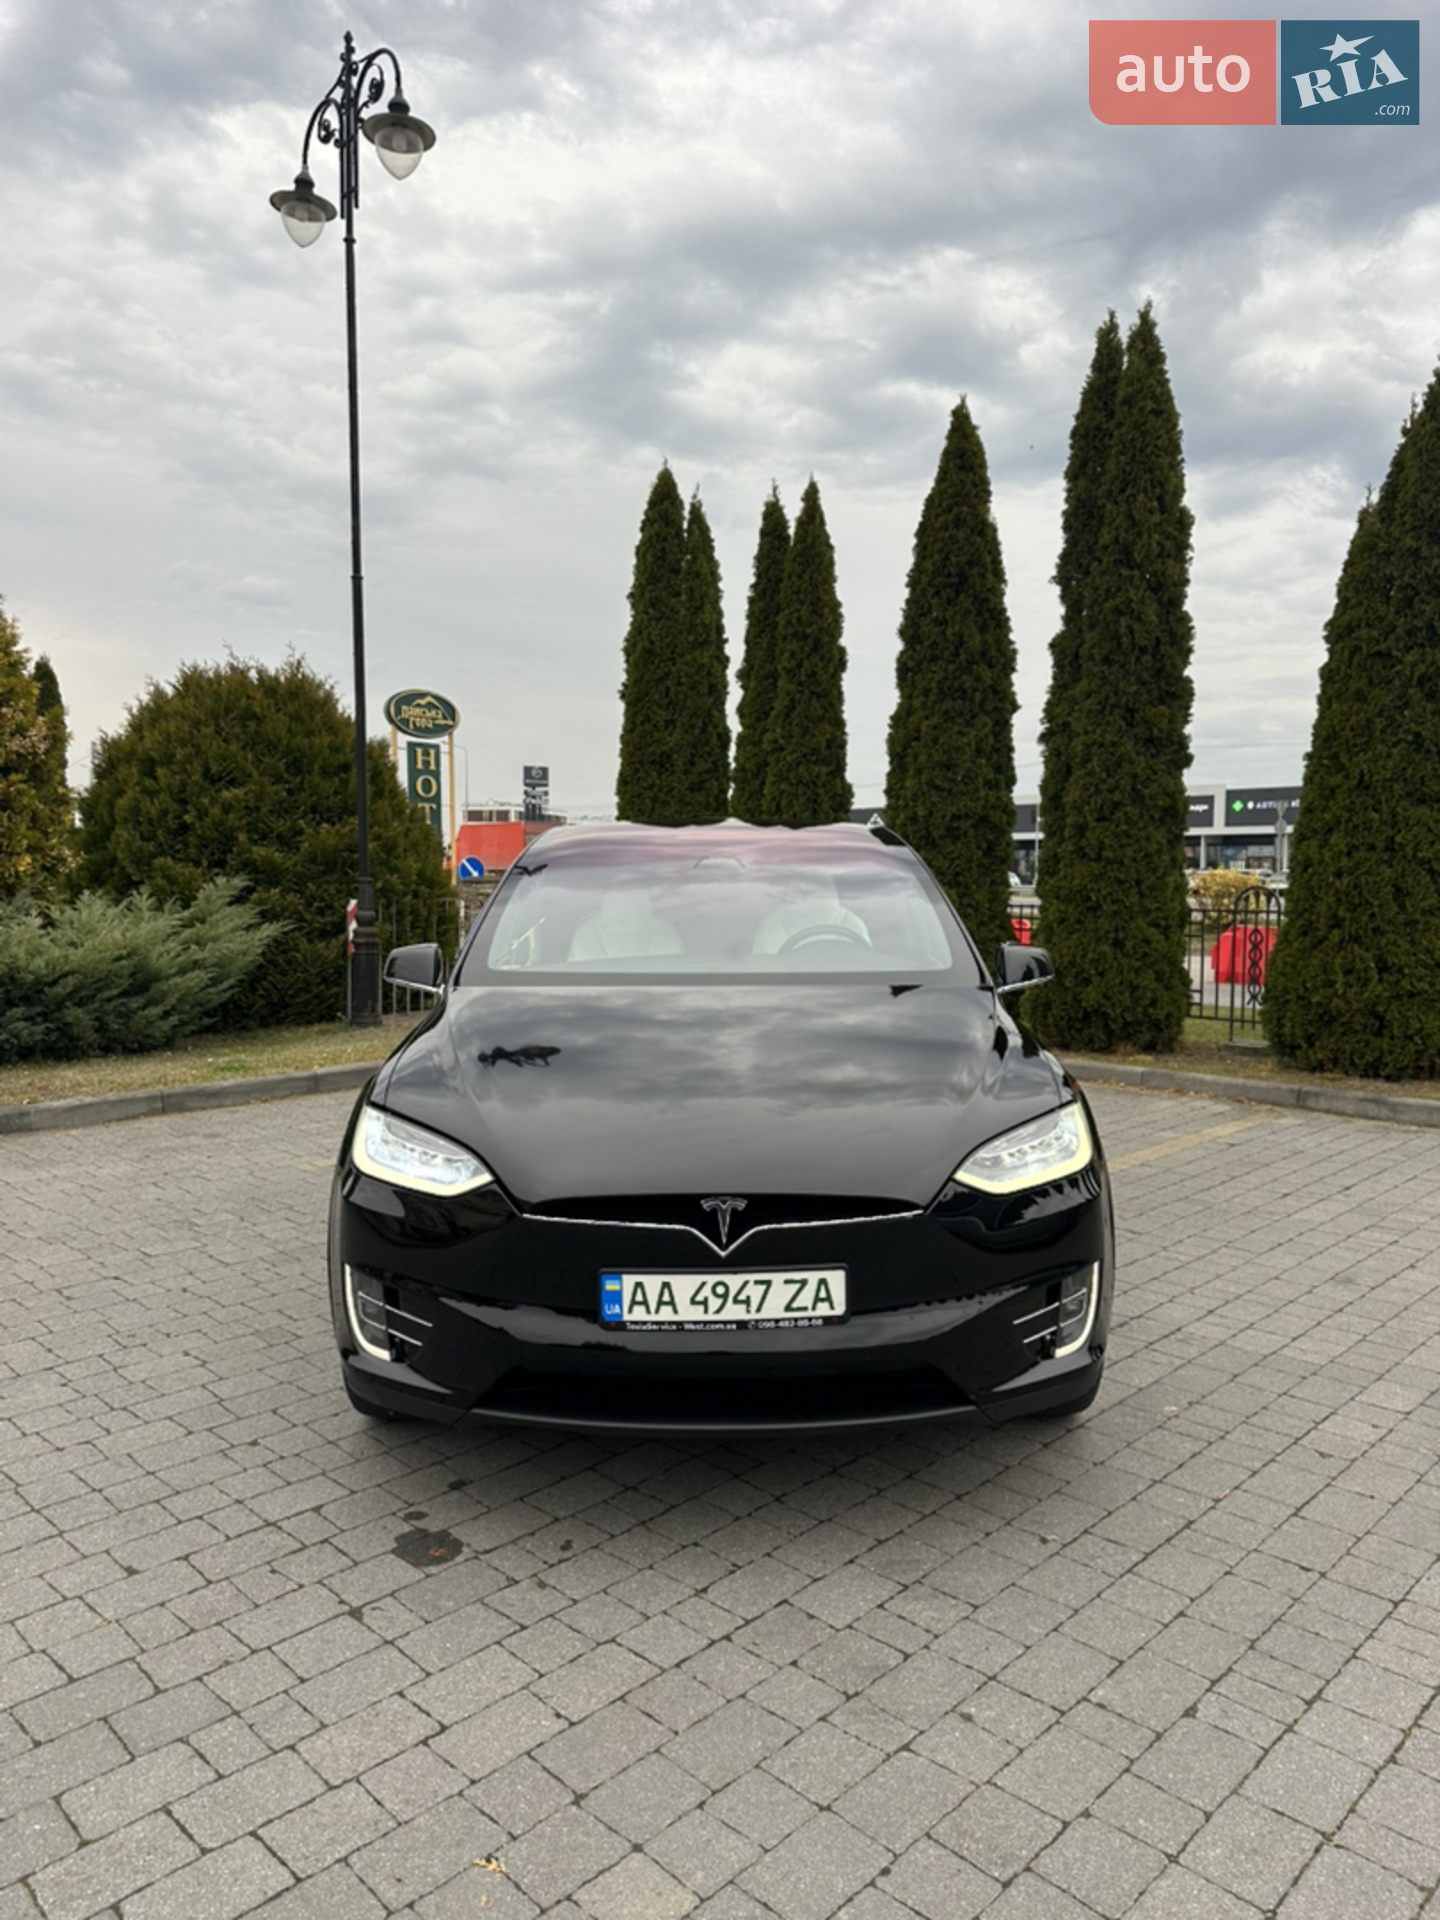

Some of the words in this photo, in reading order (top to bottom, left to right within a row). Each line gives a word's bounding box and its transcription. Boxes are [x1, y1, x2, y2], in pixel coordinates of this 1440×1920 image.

[627, 1280, 679, 1315] AA
[689, 1279, 773, 1315] 4947
[783, 1277, 835, 1312] ZA
[604, 1303, 622, 1316] UA
